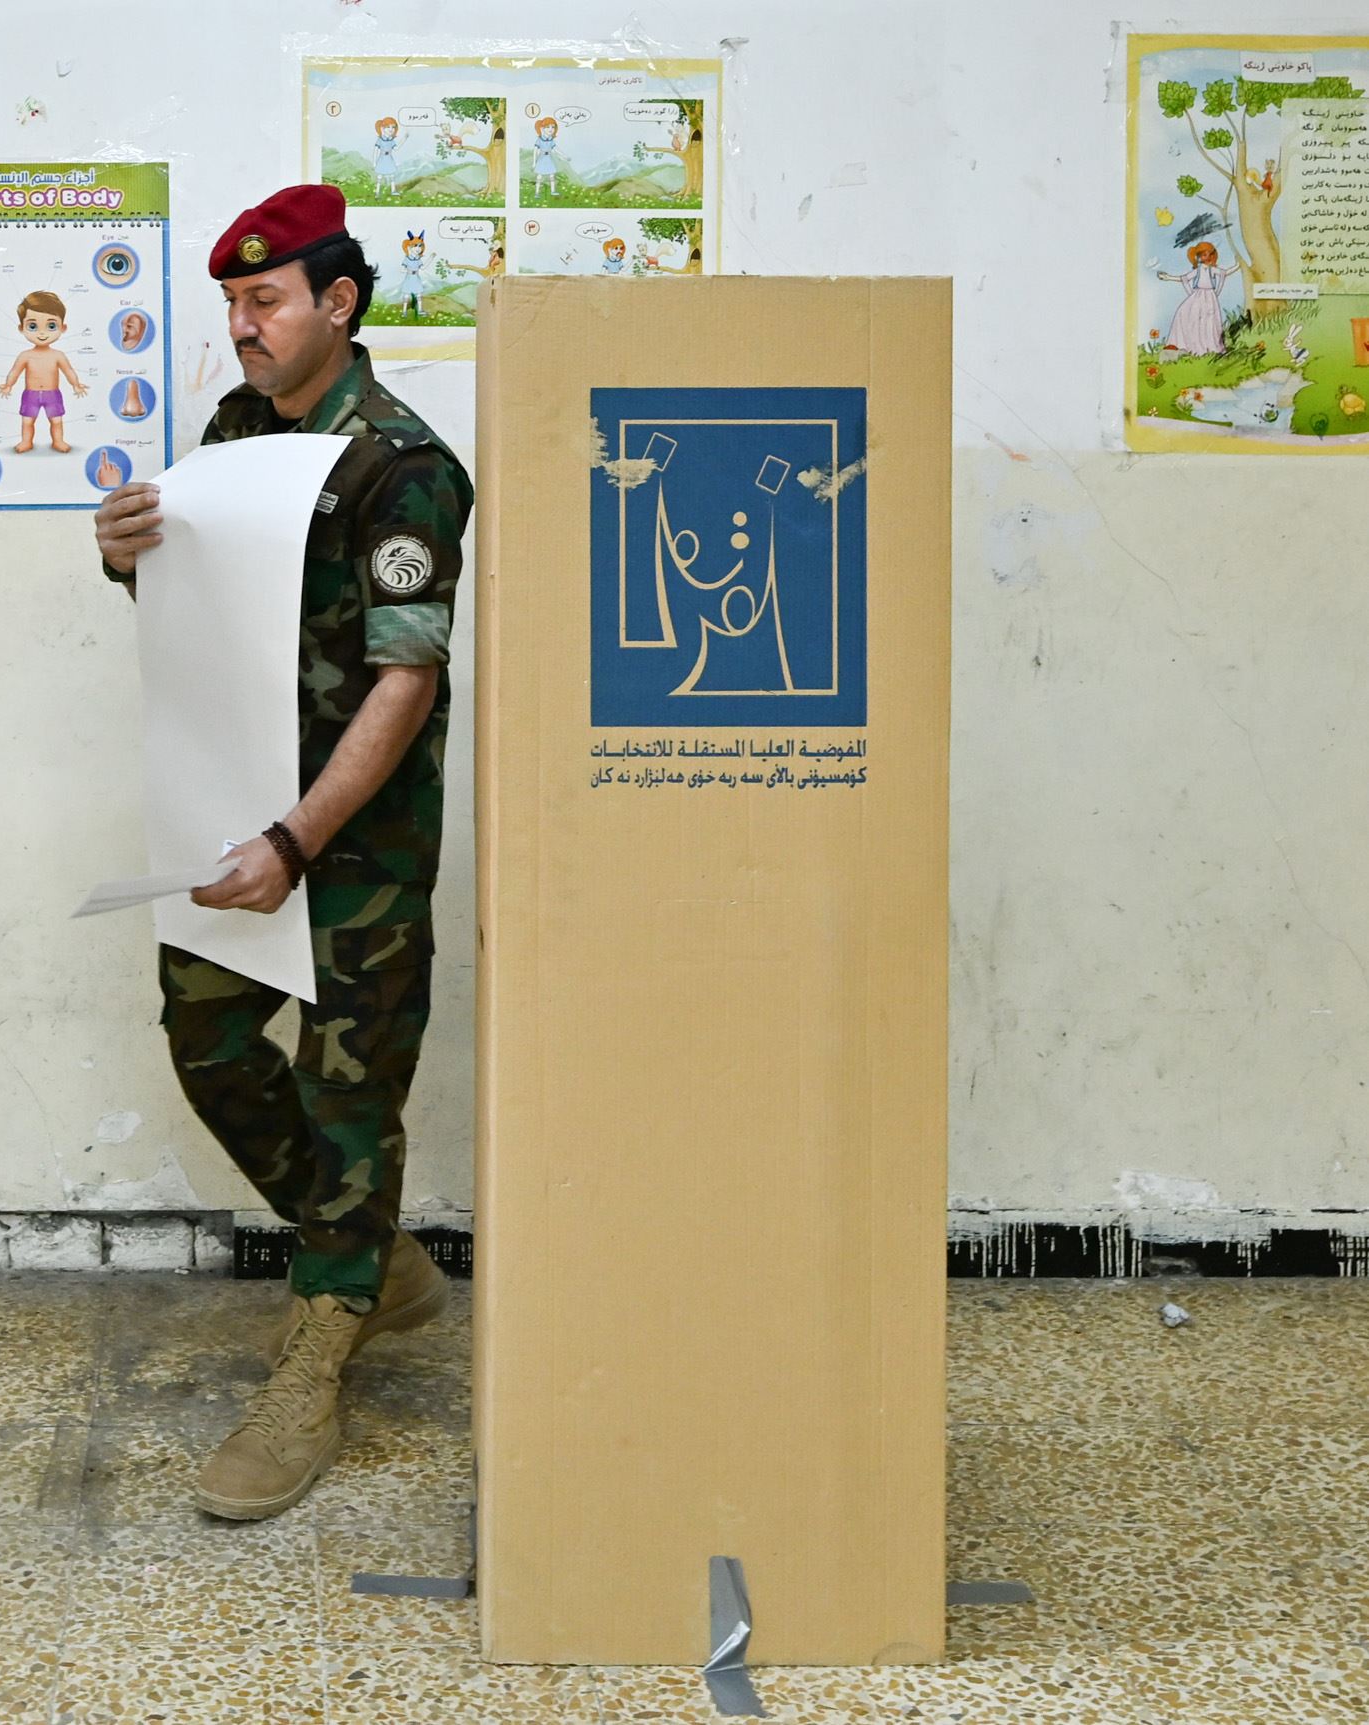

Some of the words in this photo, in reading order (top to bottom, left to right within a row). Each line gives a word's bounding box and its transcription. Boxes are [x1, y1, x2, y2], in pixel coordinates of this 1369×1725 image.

[31, 172, 62, 186] جسم
[29, 187, 57, 207] of
[60, 187, 123, 209] Body
[591, 739, 673, 762] للانتخابات
[678, 739, 745, 758] المستقلة
[750, 739, 794, 762] العليا
[799, 739, 866, 762] المفوضية
